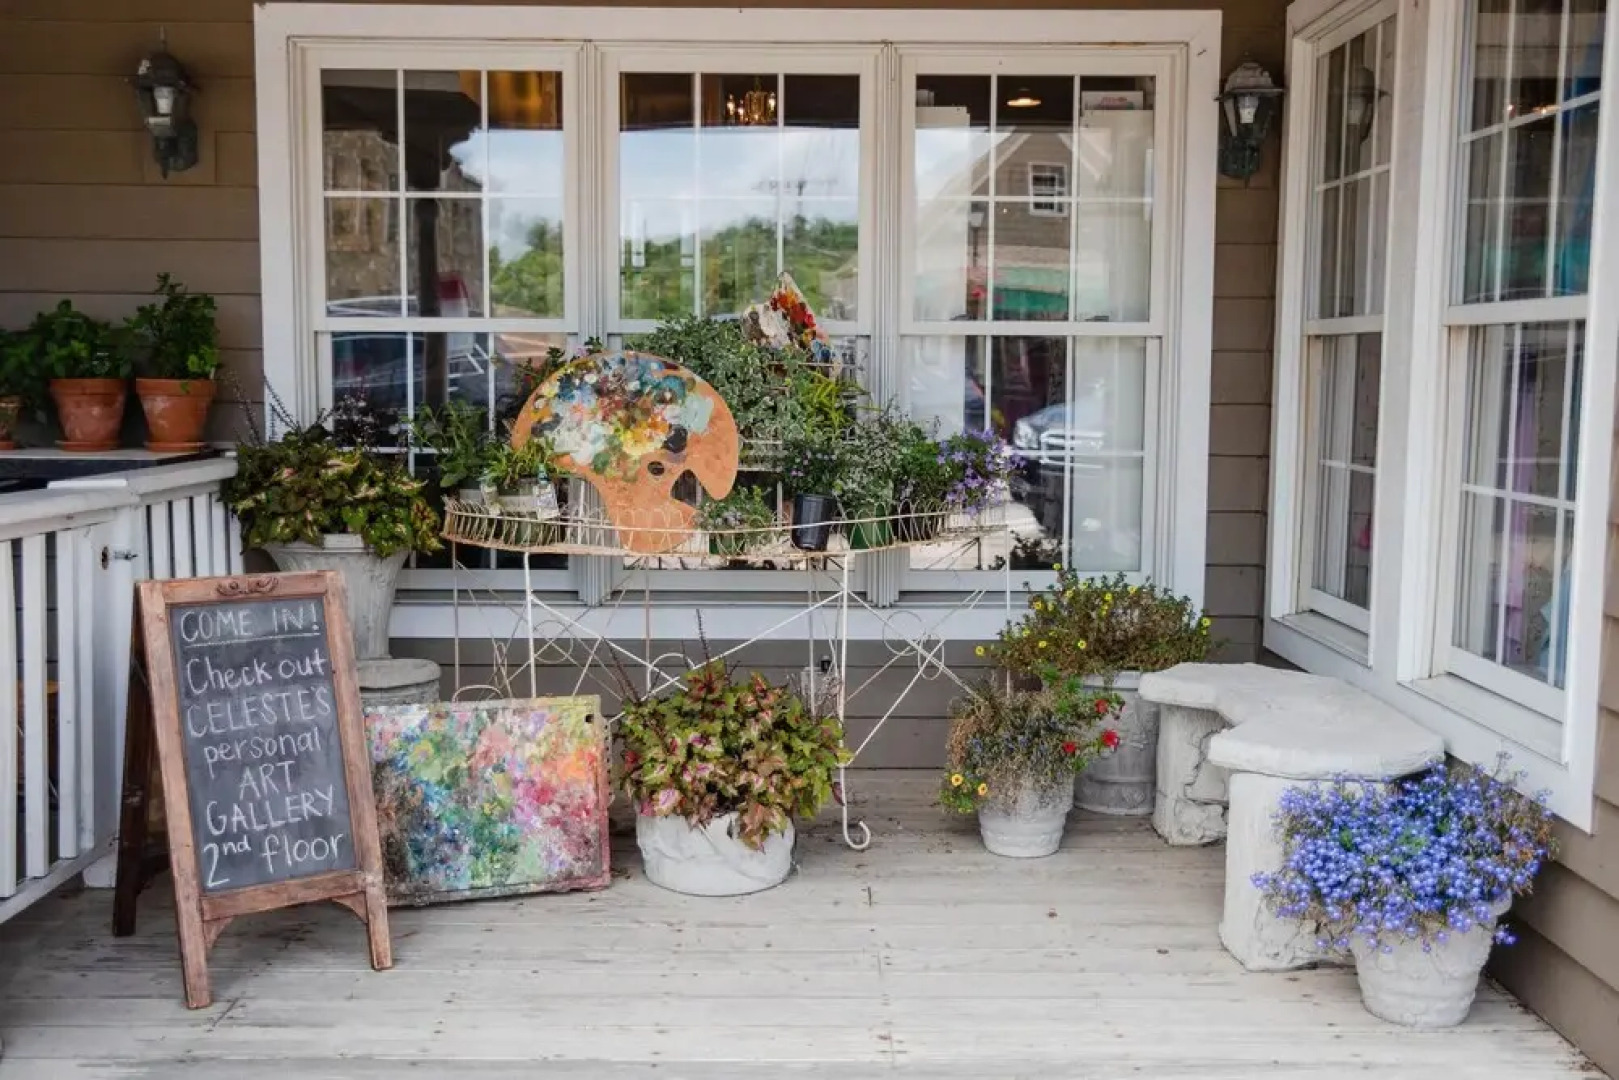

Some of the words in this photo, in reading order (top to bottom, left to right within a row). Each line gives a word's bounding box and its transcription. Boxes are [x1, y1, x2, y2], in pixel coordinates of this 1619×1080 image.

[181, 609, 253, 642] COME
[272, 603, 320, 632] IN!
[186, 656, 273, 694] Check
[279, 648, 327, 679] out
[187, 686, 331, 738] CELESTE'S
[203, 727, 322, 780] personal
[239, 761, 295, 800] ART
[206, 784, 334, 836] GALLERY
[203, 834, 252, 887] 2nd
[261, 833, 344, 874] floor
